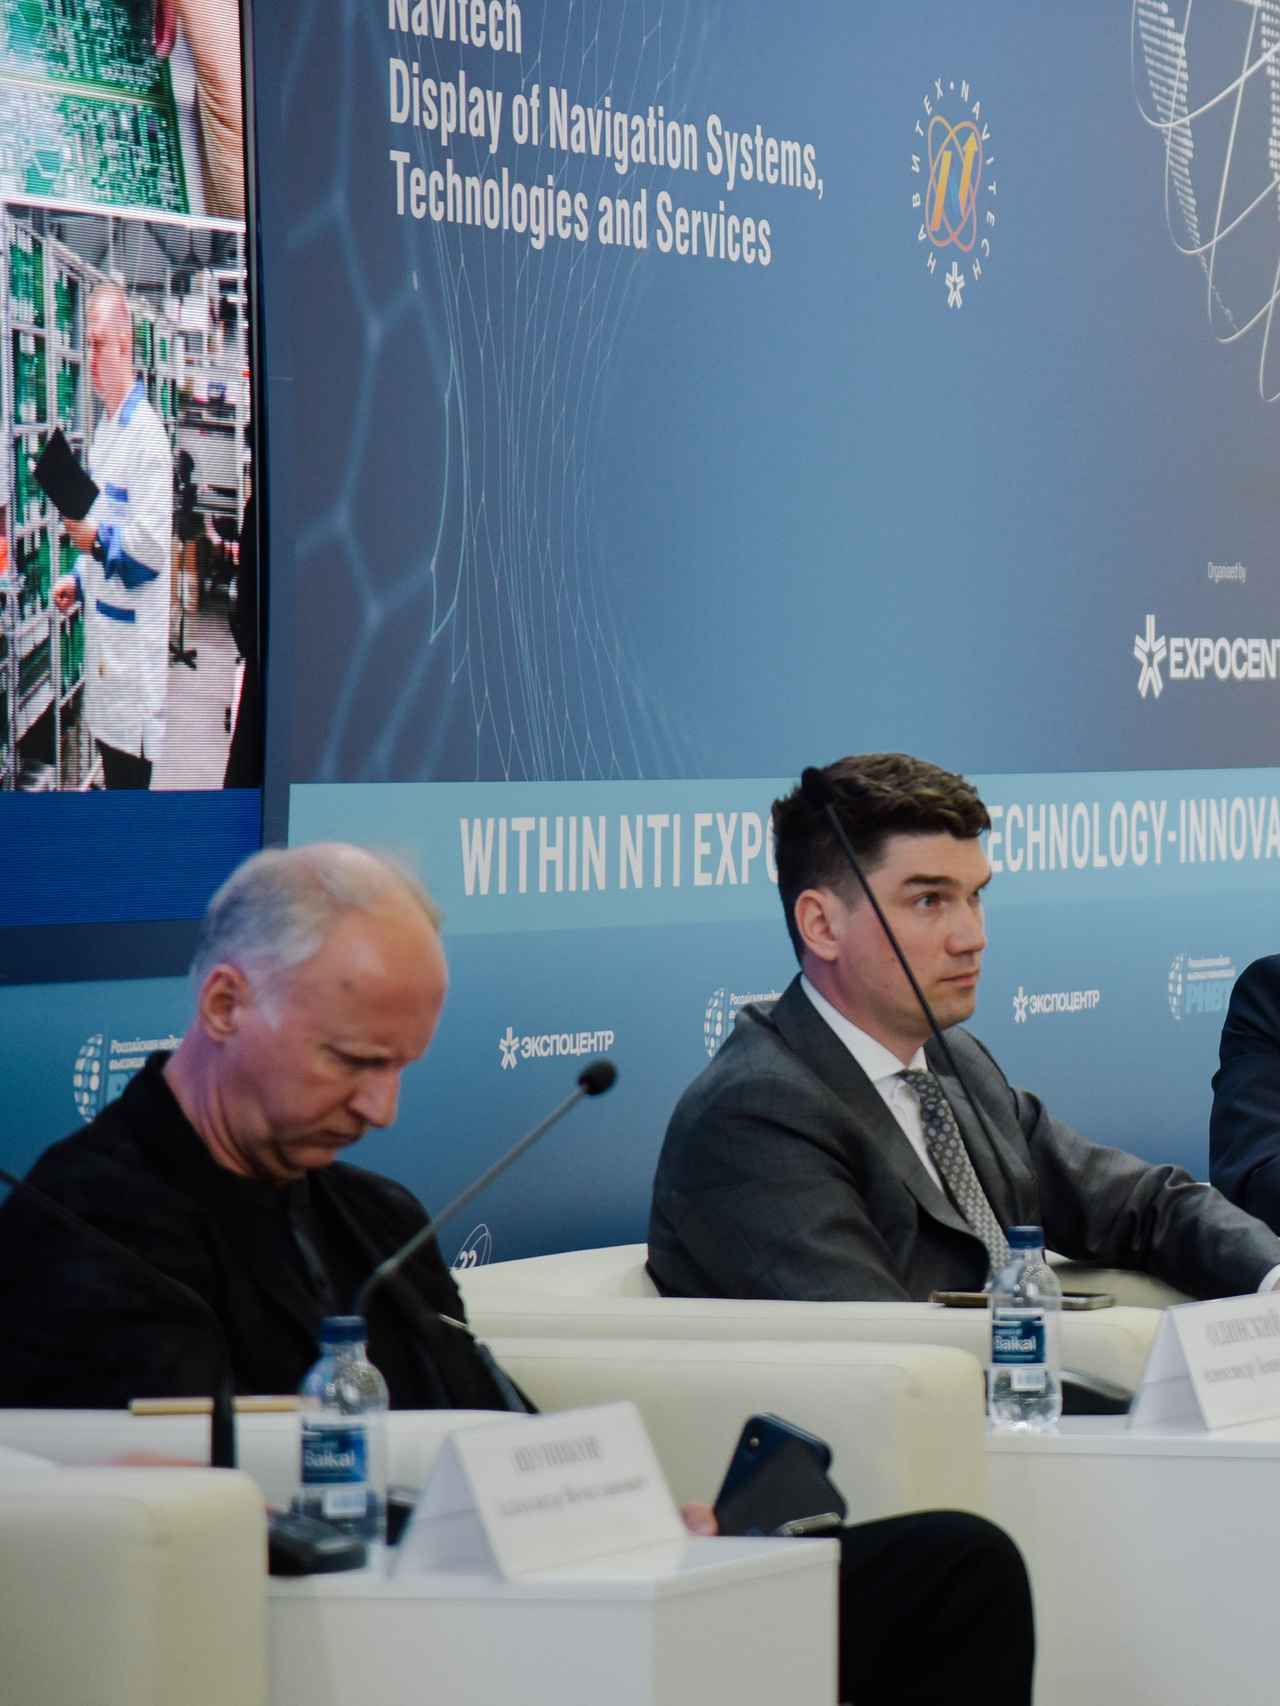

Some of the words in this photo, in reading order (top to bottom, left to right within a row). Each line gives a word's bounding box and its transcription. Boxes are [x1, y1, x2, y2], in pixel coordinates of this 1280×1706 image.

[389, 57, 503, 154] Display
[512, 84, 540, 146] of
[549, 86, 698, 175] Navigation
[706, 114, 824, 200] Systems,
[389, 149, 589, 250] Technologies
[598, 188, 648, 249] and
[656, 191, 771, 266] Services
[460, 815, 606, 896] WITHIN
[619, 813, 681, 889] NTI
[1029, 989, 1100, 1014] ЭКСПОЦЕНТР
[520, 1030, 614, 1059] ЭКСПОЦЕНТР
